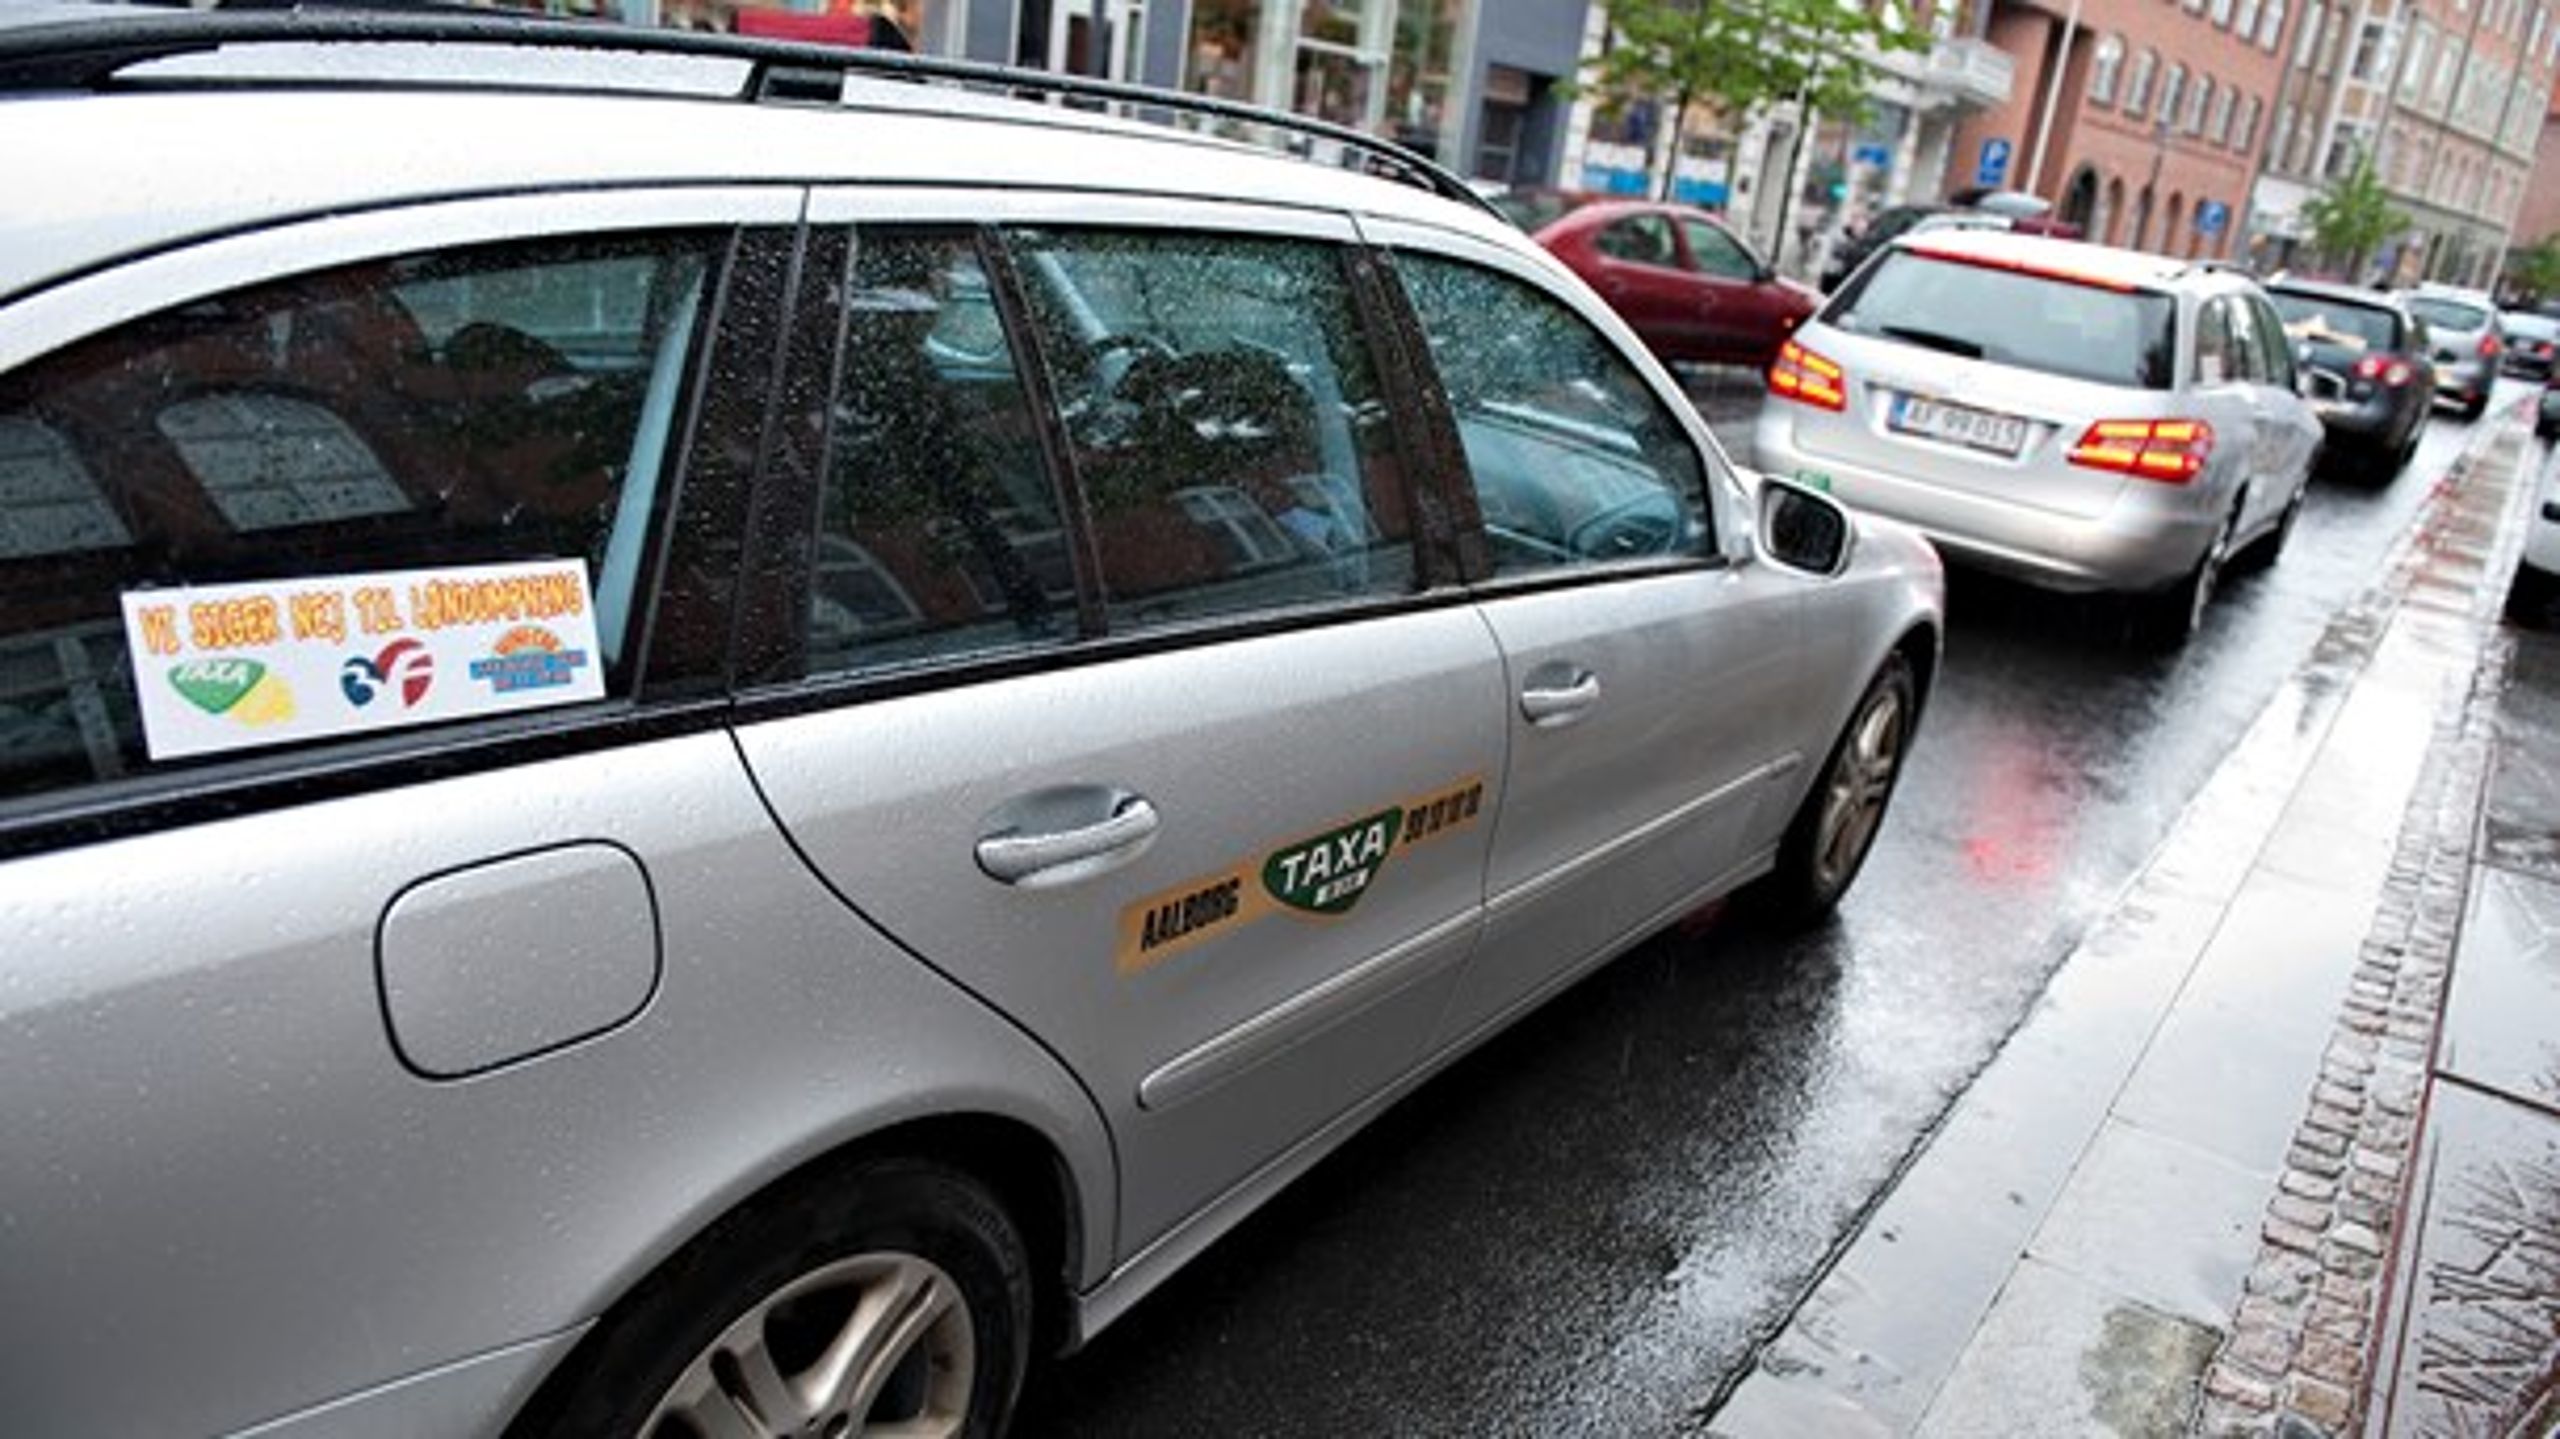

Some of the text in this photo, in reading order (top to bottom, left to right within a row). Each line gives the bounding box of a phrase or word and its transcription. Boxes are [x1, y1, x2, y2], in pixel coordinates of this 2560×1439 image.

[140, 606, 180, 654] VI
[190, 597, 279, 648] SIGER
[290, 591, 345, 645] NEJ
[353, 588, 402, 634] TIL
[1279, 821, 1386, 895] TAXA
[1140, 876, 1240, 952] AALBORG
